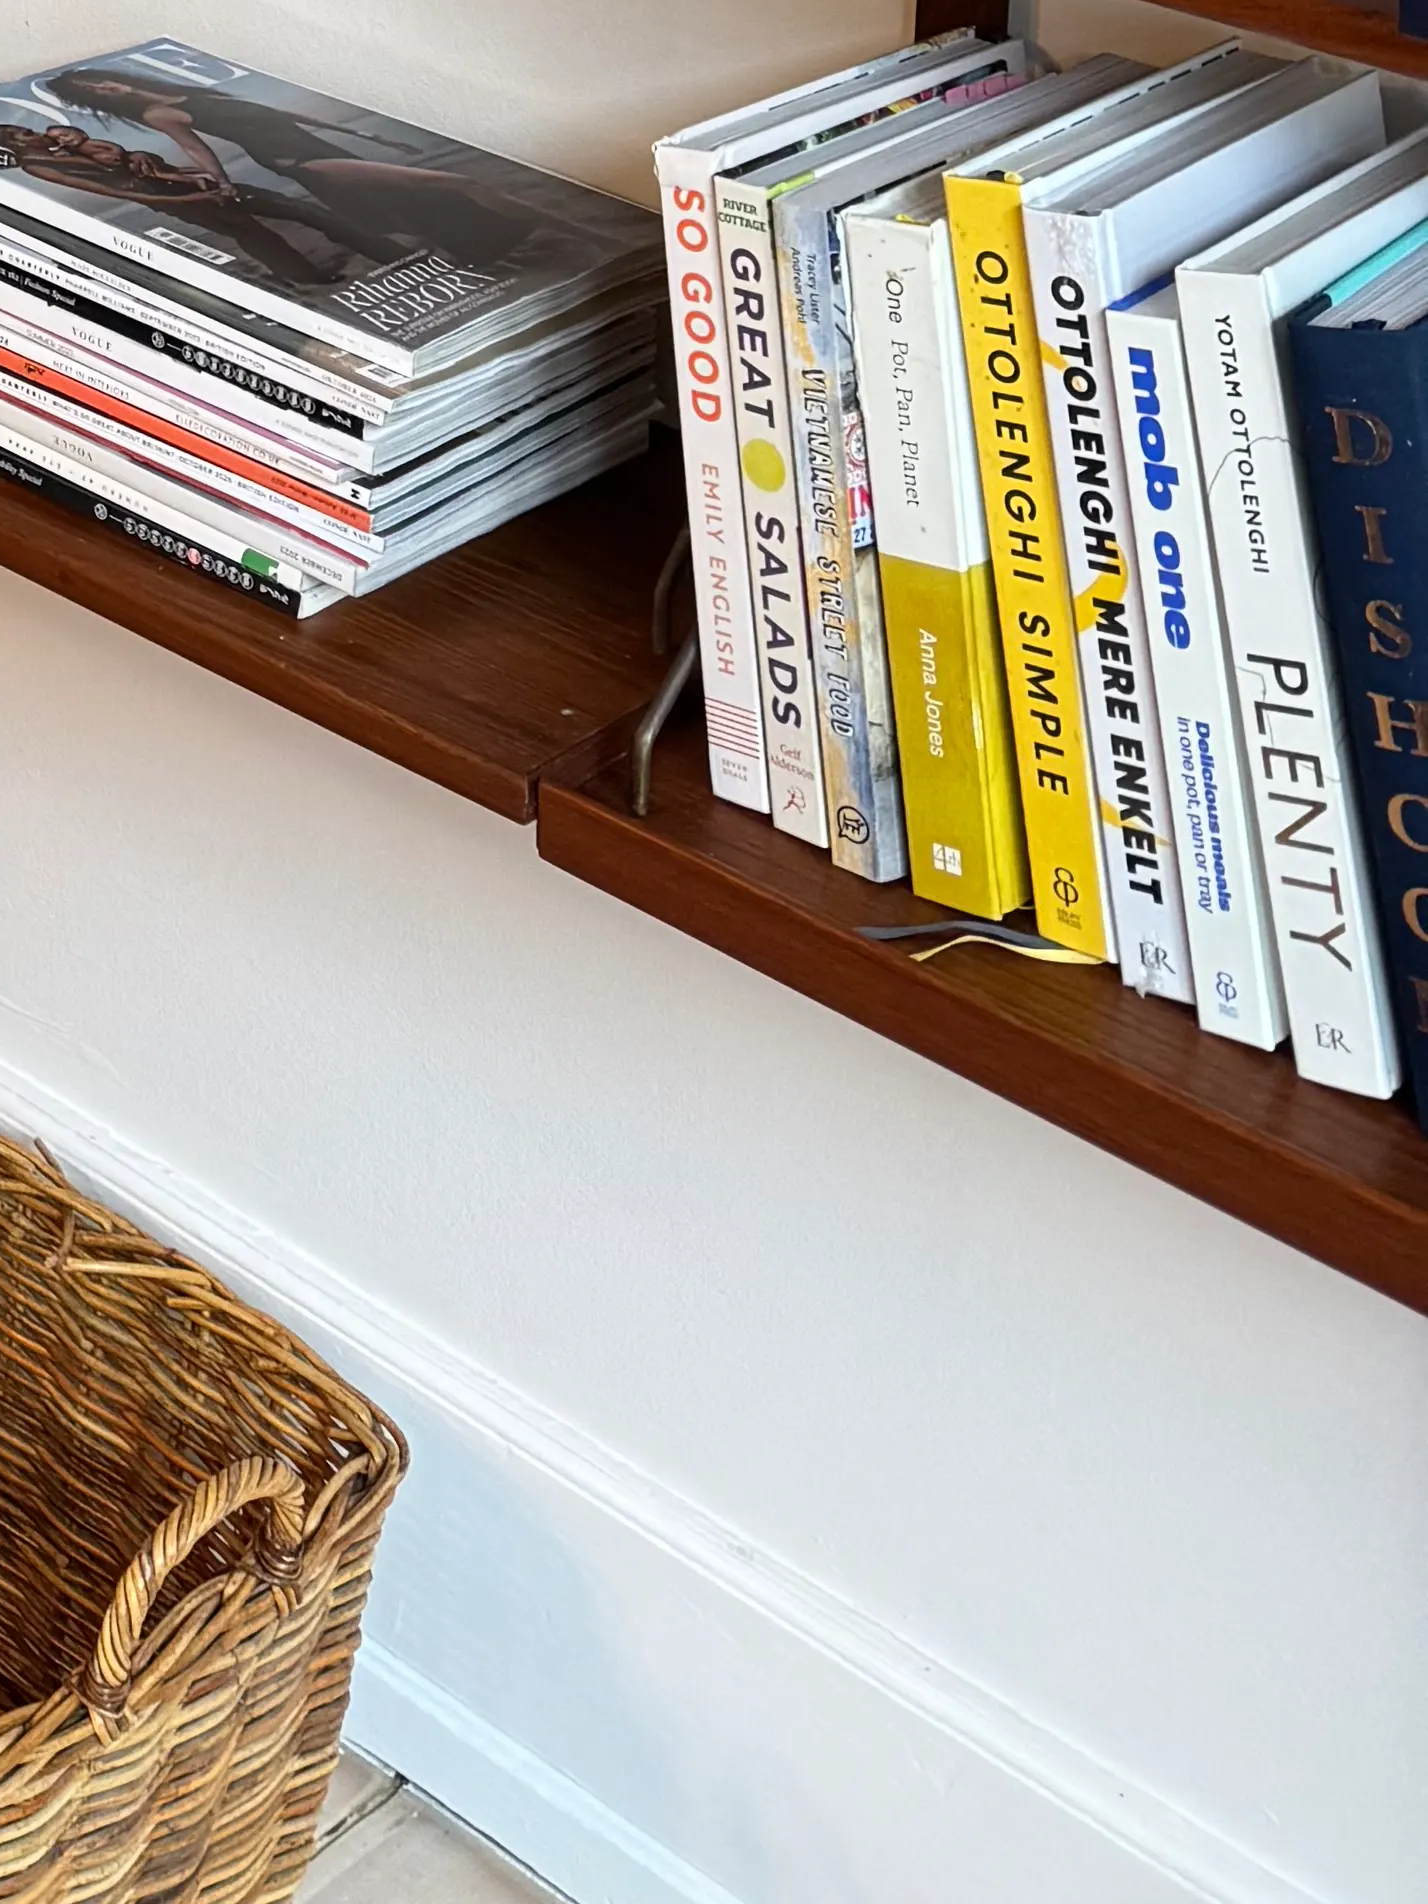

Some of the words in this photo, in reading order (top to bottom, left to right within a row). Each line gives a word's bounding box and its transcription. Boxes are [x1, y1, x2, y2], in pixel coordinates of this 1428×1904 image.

[112, 235, 155, 262] VOGUE
[671, 184, 709, 253] SO
[717, 213, 768, 232] COTTAGE
[723, 197, 758, 216] RIVER
[71, 325, 114, 353] VOGUE
[332, 254, 454, 315] Rihanna
[727, 247, 778, 428] GREAT
[679, 271, 723, 424] GOOD
[1213, 313, 1245, 403] YOTAM
[52, 433, 94, 463] VOGUE
[800, 369, 839, 540] VIETNAMESE
[1047, 273, 1125, 578] OTTOLENGHI
[1127, 346, 1179, 514] mob
[701, 462, 726, 545] EMILY
[974, 250, 1044, 585] OTTOLENGHI
[1017, 610, 1071, 798] SIMPLE
[1228, 409, 1271, 576] OTTOLENGHI
[709, 555, 736, 677] ENGLISH
[753, 508, 804, 730] SALADS
[816, 555, 847, 661] STREET
[1150, 528, 1192, 652] one
[826, 665, 857, 738] FOOD
[916, 627, 940, 686] Anna
[1091, 600, 1142, 722] MERE
[923, 691, 947, 761] Jones
[1195, 721, 1223, 834] Delicious
[1110, 732, 1165, 907] ENKELT
[1235, 652, 1353, 974] PLENTY
[1208, 837, 1232, 914] meals
